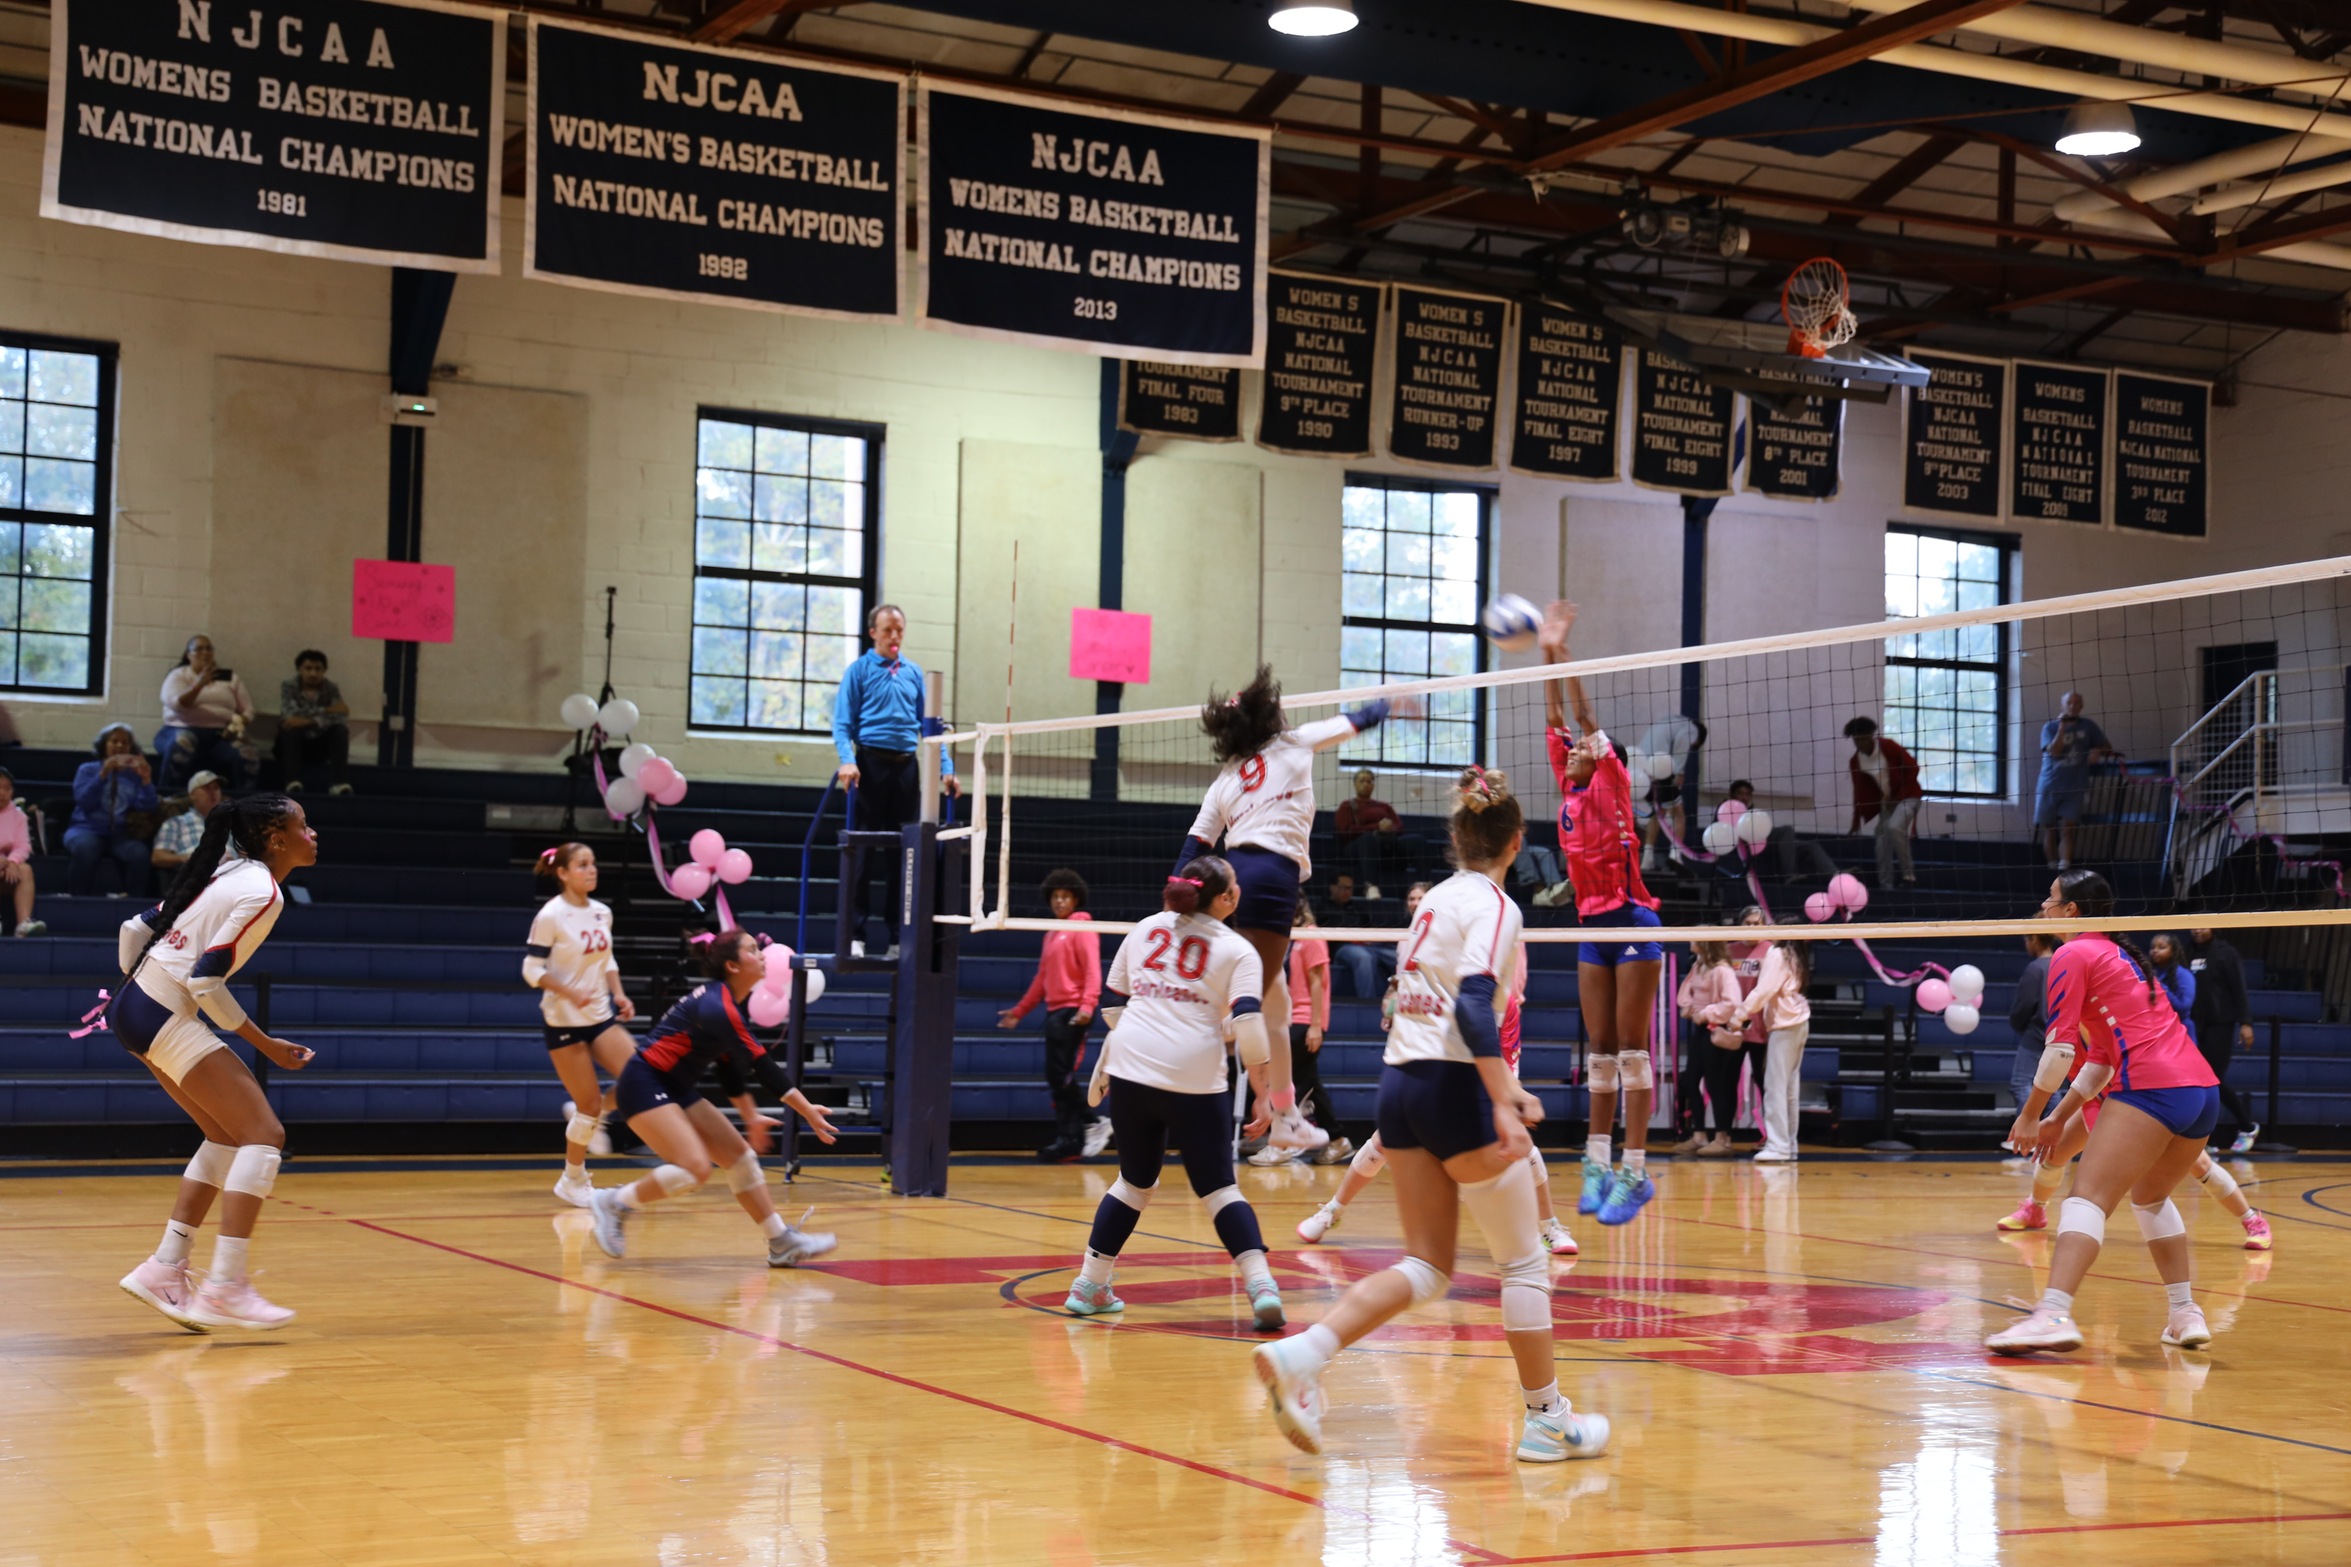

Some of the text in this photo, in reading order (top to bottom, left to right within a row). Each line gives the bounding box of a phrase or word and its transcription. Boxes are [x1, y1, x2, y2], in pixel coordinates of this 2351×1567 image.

[79, 46, 479, 137] WOMENS BASKETBALL
[643, 62, 802, 121] NJCAA
[78, 105, 474, 192] NATIONAL CHAMPIONS
[549, 113, 888, 191] WOMEN'S BASKETBALL
[1031, 132, 1164, 186] NJCAA
[257, 189, 306, 217] 1981
[553, 174, 883, 248] NATIONAL CHAMPIONS
[949, 178, 1239, 243] WOMENS BASKETBALL
[699, 254, 747, 280] 1992
[944, 229, 1240, 291] NATIONAL CHAMPIONS
[1073, 297, 1117, 321] 2013
[1276, 307, 1366, 334] BASKETBALL
[1295, 332, 1345, 353] NJCAA
[1405, 322, 1494, 348] BASKETBALL
[1529, 336, 1611, 363] BASKETBALL
[1137, 361, 1230, 383] TOURNAMENT
[1285, 353, 1352, 375] NATIONAL
[1272, 373, 1365, 398] TOURNAMENT
[1413, 366, 1480, 390] NATIONAL
[1138, 379, 1225, 405] FINAL FOUR
[1401, 385, 1491, 412] TOURNAMENT
[1538, 379, 1598, 403] NATIONAL
[1918, 386, 1994, 408] BASKETBALL
[1164, 404, 1198, 423] 1983
[1303, 399, 1349, 418] PLACE
[1525, 399, 1609, 425] TOURNAMENT
[1654, 394, 1714, 417] NATIONAL
[1934, 406, 1976, 426] NJCAA
[1297, 420, 1333, 438] 1990
[1403, 407, 1484, 432] RUNNER-UP
[1642, 413, 1724, 437] TOURNAMENT
[2023, 407, 2096, 429] BASKETBALL
[2128, 419, 2193, 441] BASKETBALL
[1426, 432, 1459, 450] 1993
[1524, 420, 1604, 445] FINAL EIGHT
[1758, 425, 1834, 447] TOURNAMENT
[1927, 424, 1982, 445] NATIONAL
[1548, 445, 1581, 462] 1997
[1644, 434, 1723, 458] FINAL EIGHT
[1789, 449, 1827, 466] PLACE
[1916, 441, 1991, 464] TOURNAMENT
[2120, 440, 2201, 464] NJCAA NATIONAL
[1666, 457, 1698, 475] 1999
[1780, 469, 1807, 486] 2001
[1939, 463, 1981, 482] PLACE
[2022, 462, 2094, 484] TOURNAMENT
[2126, 463, 2190, 484] TOURNAMENT
[1937, 483, 1969, 500] 2003
[2022, 482, 2094, 503] FINAL EIGHT
[2154, 487, 2185, 504] PLACE
[1238, 753, 1267, 793] 9
[1561, 803, 1574, 834] 6
[581, 929, 608, 956] 23
[1401, 908, 1435, 975] 2
[1142, 926, 1210, 982] 20
